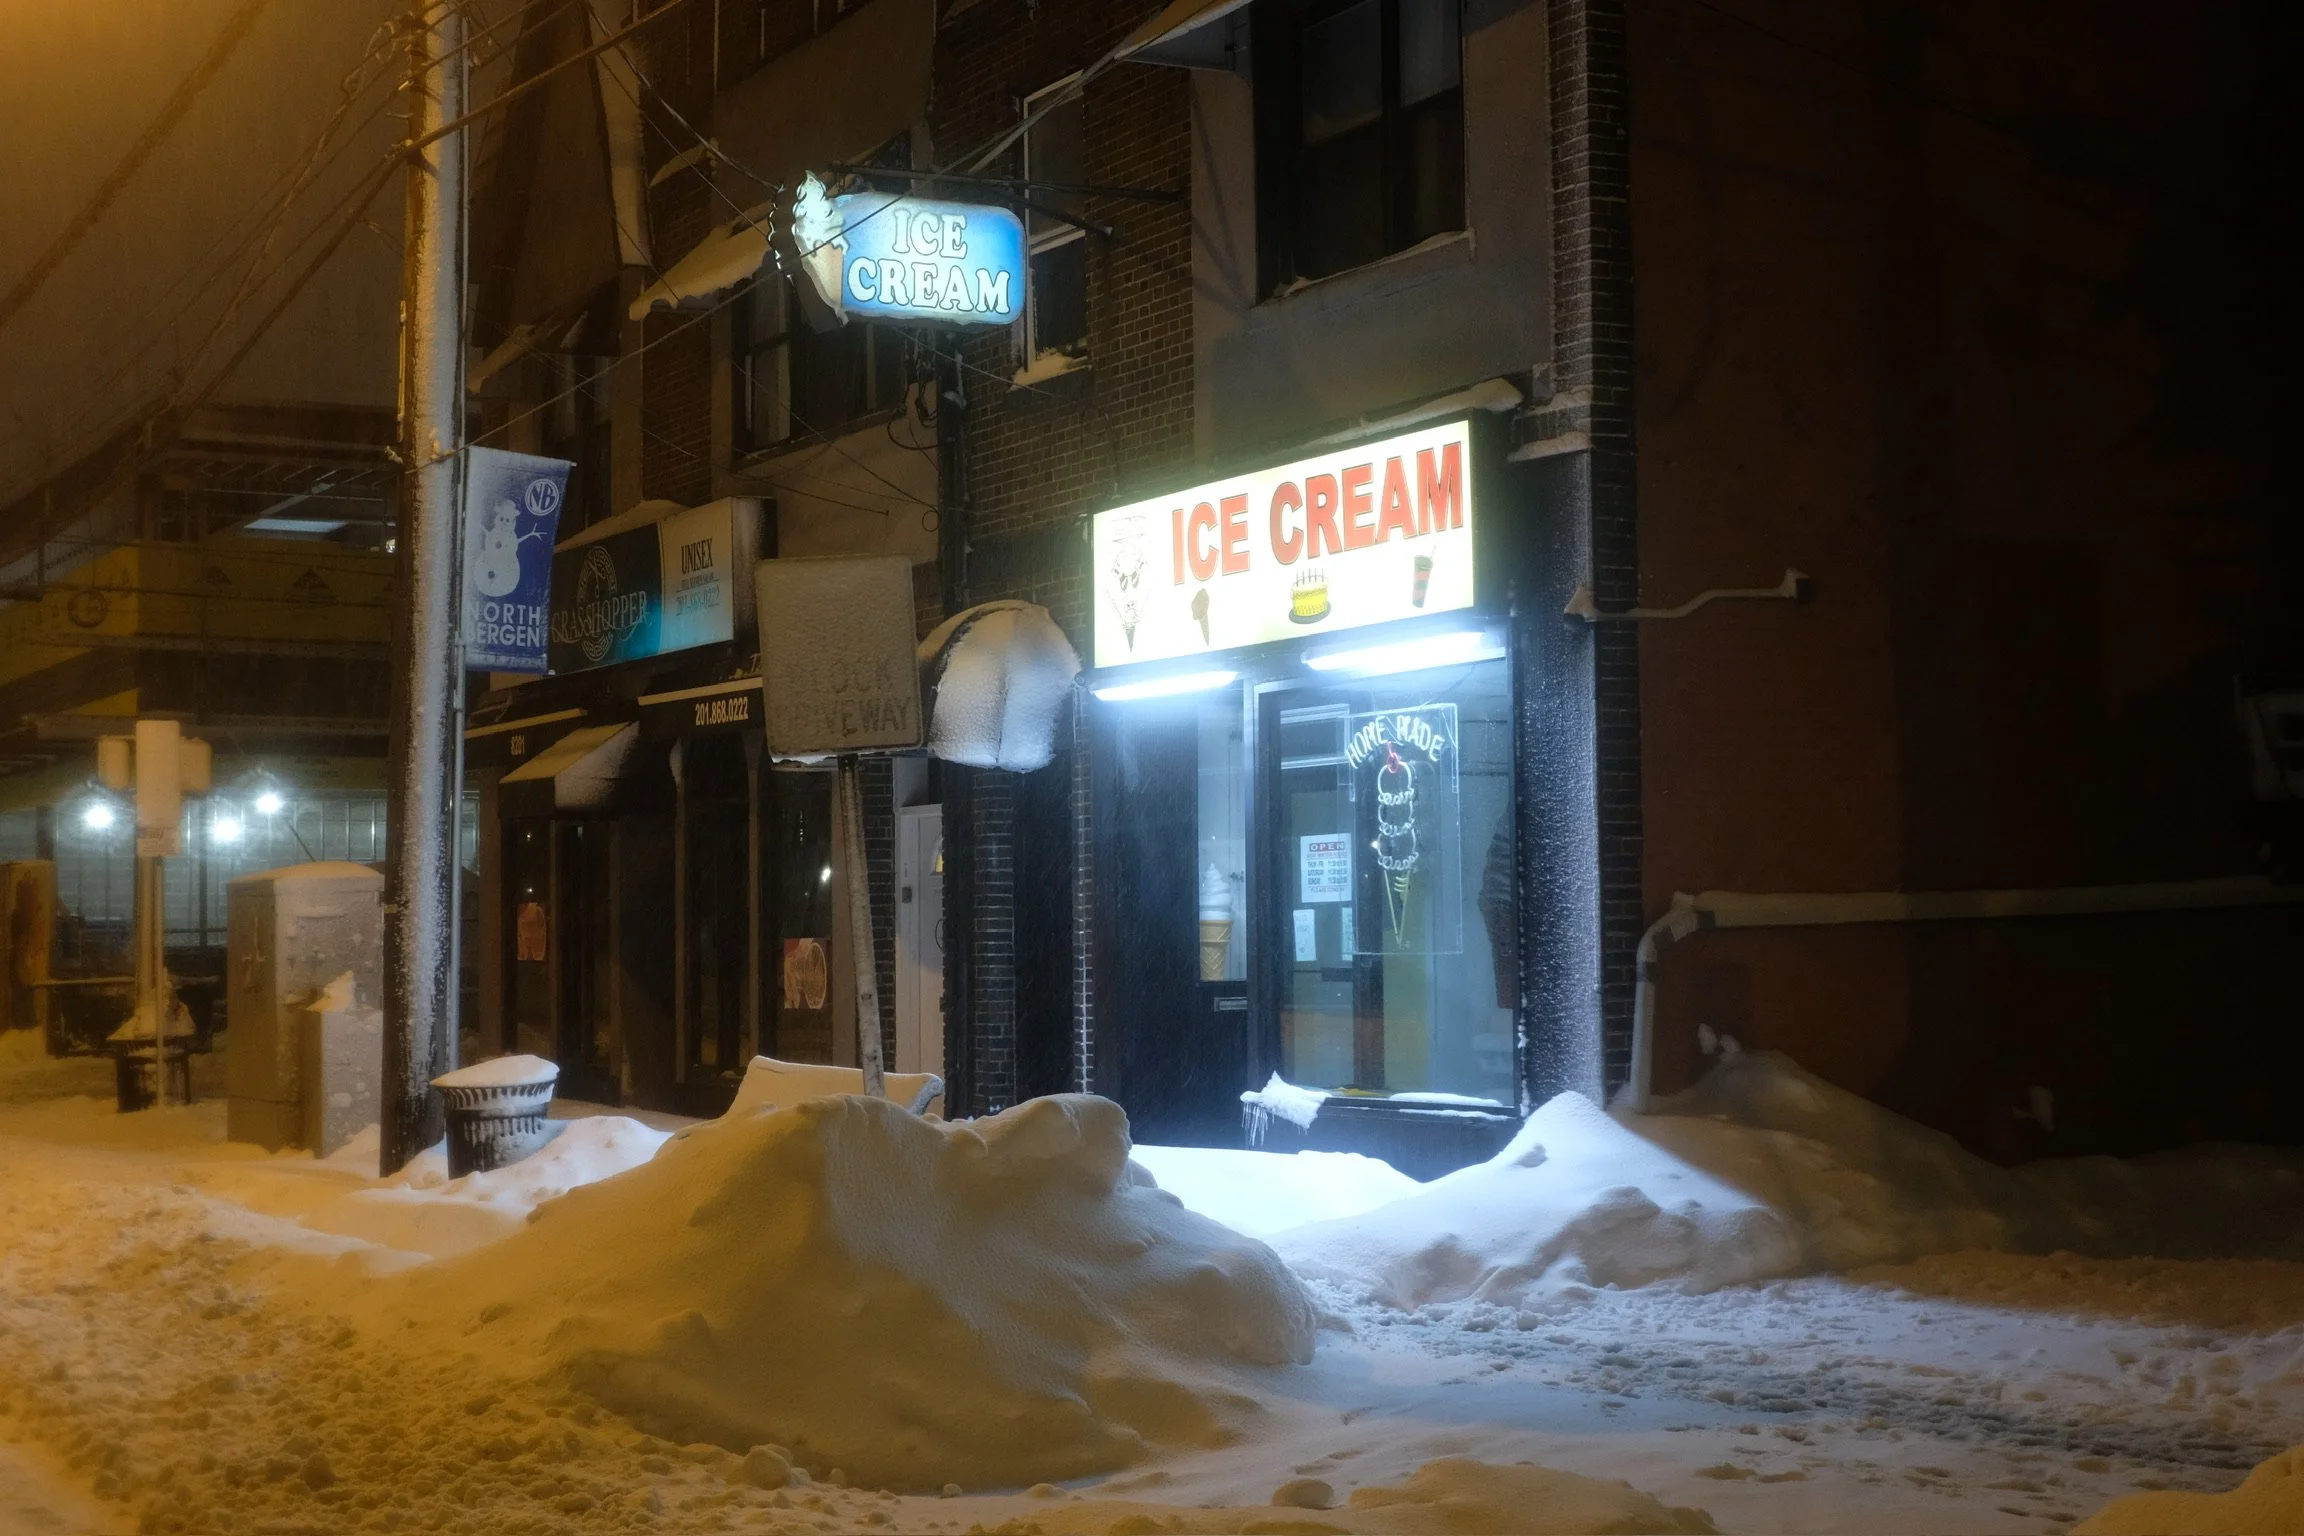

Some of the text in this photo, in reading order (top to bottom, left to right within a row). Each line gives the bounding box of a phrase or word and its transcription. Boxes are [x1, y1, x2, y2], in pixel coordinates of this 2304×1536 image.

[892, 208, 968, 259] ICE
[848, 257, 1010, 315] CREAM
[528, 481, 555, 513] NB
[1172, 441, 1464, 586] ICE CREAM
[681, 537, 713, 575] UNISEX
[465, 601, 541, 626] NORTH
[551, 590, 648, 644] GRASSHOPPER
[466, 621, 541, 648] BERGEN
[695, 696, 750, 726] 201.868.0222
[1345, 715, 1446, 769] HOME MADE
[1310, 842, 1345, 851] OPEN
